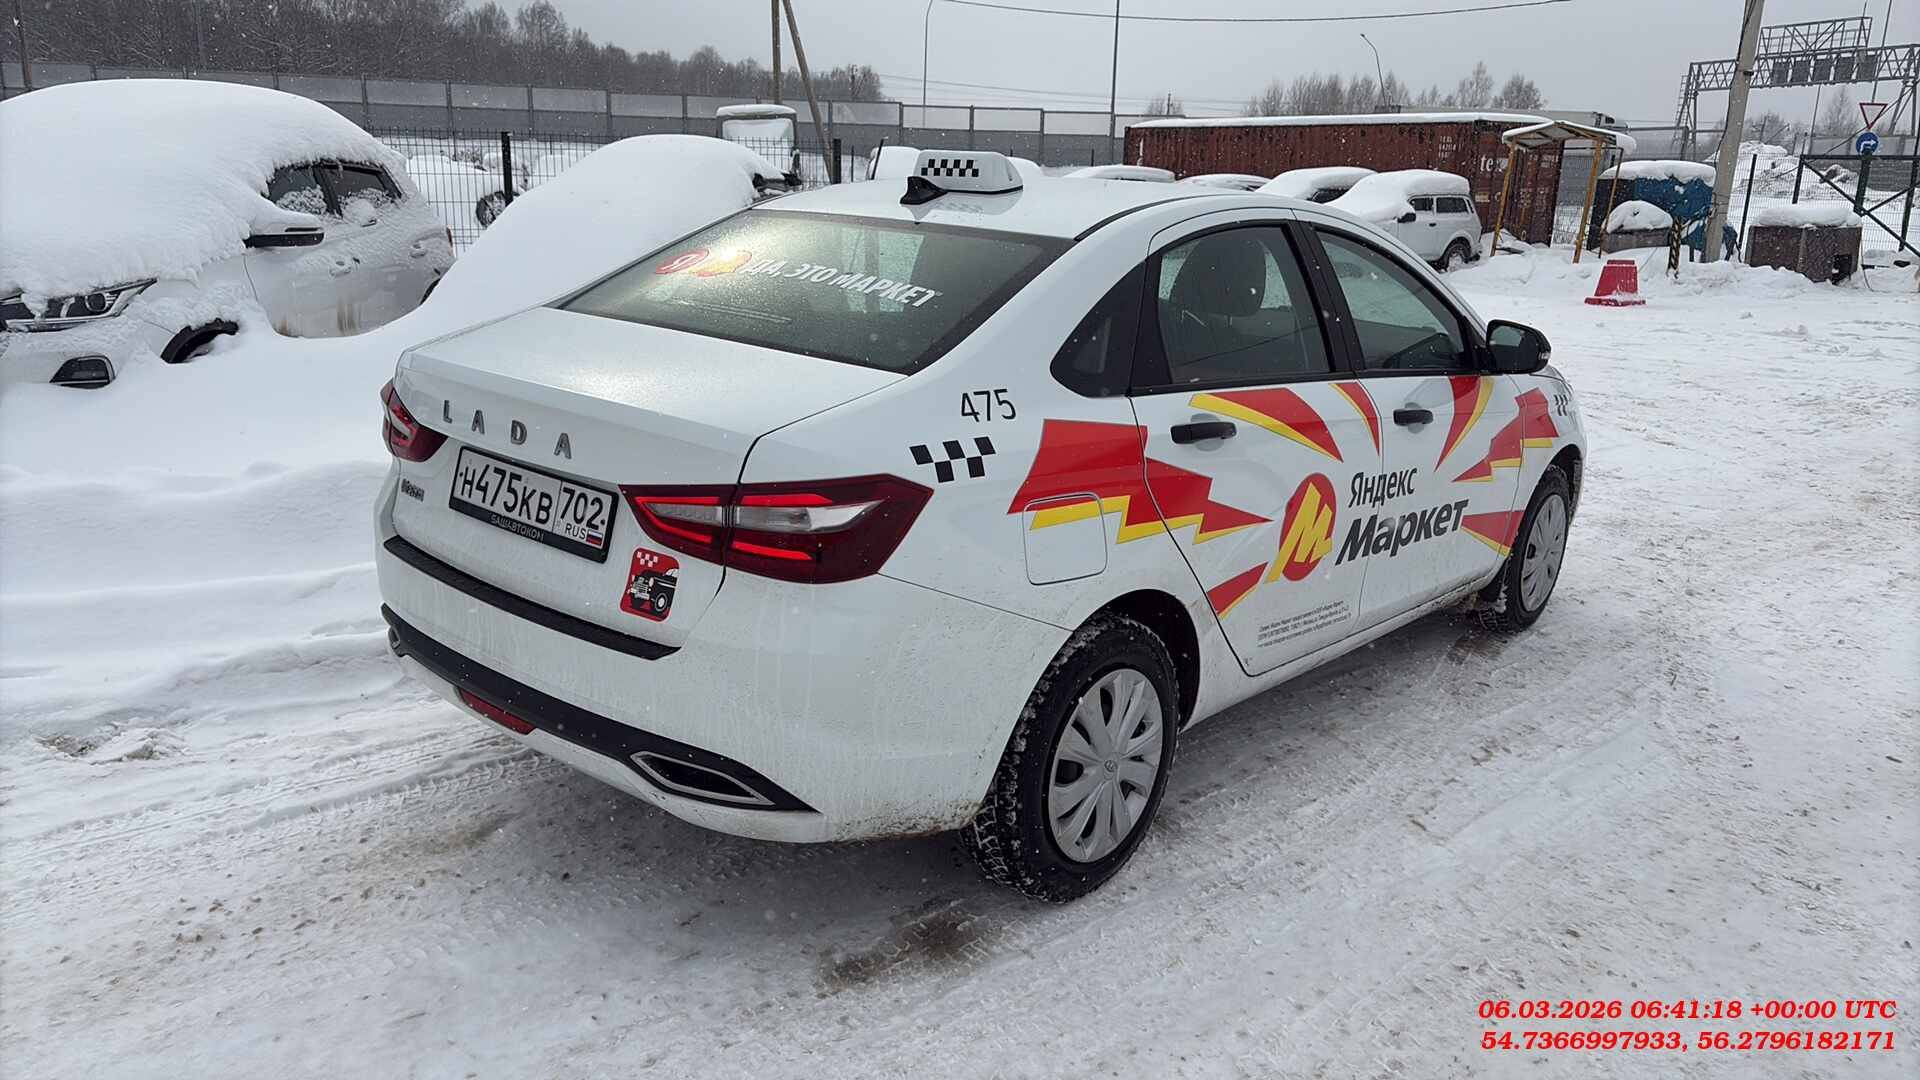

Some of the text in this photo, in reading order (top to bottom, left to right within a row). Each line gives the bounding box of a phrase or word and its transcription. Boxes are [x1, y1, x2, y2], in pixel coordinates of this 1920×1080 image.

[784, 263, 838, 282] ЭТО
[828, 272, 936, 307] МАРКЕТ
[961, 388, 1016, 422] 475
[442, 399, 573, 460] LADA
[559, 486, 604, 531] 702
[1348, 467, 1418, 508] Яндекс
[564, 522, 587, 541] RUS
[1334, 498, 1470, 567] Маркет
